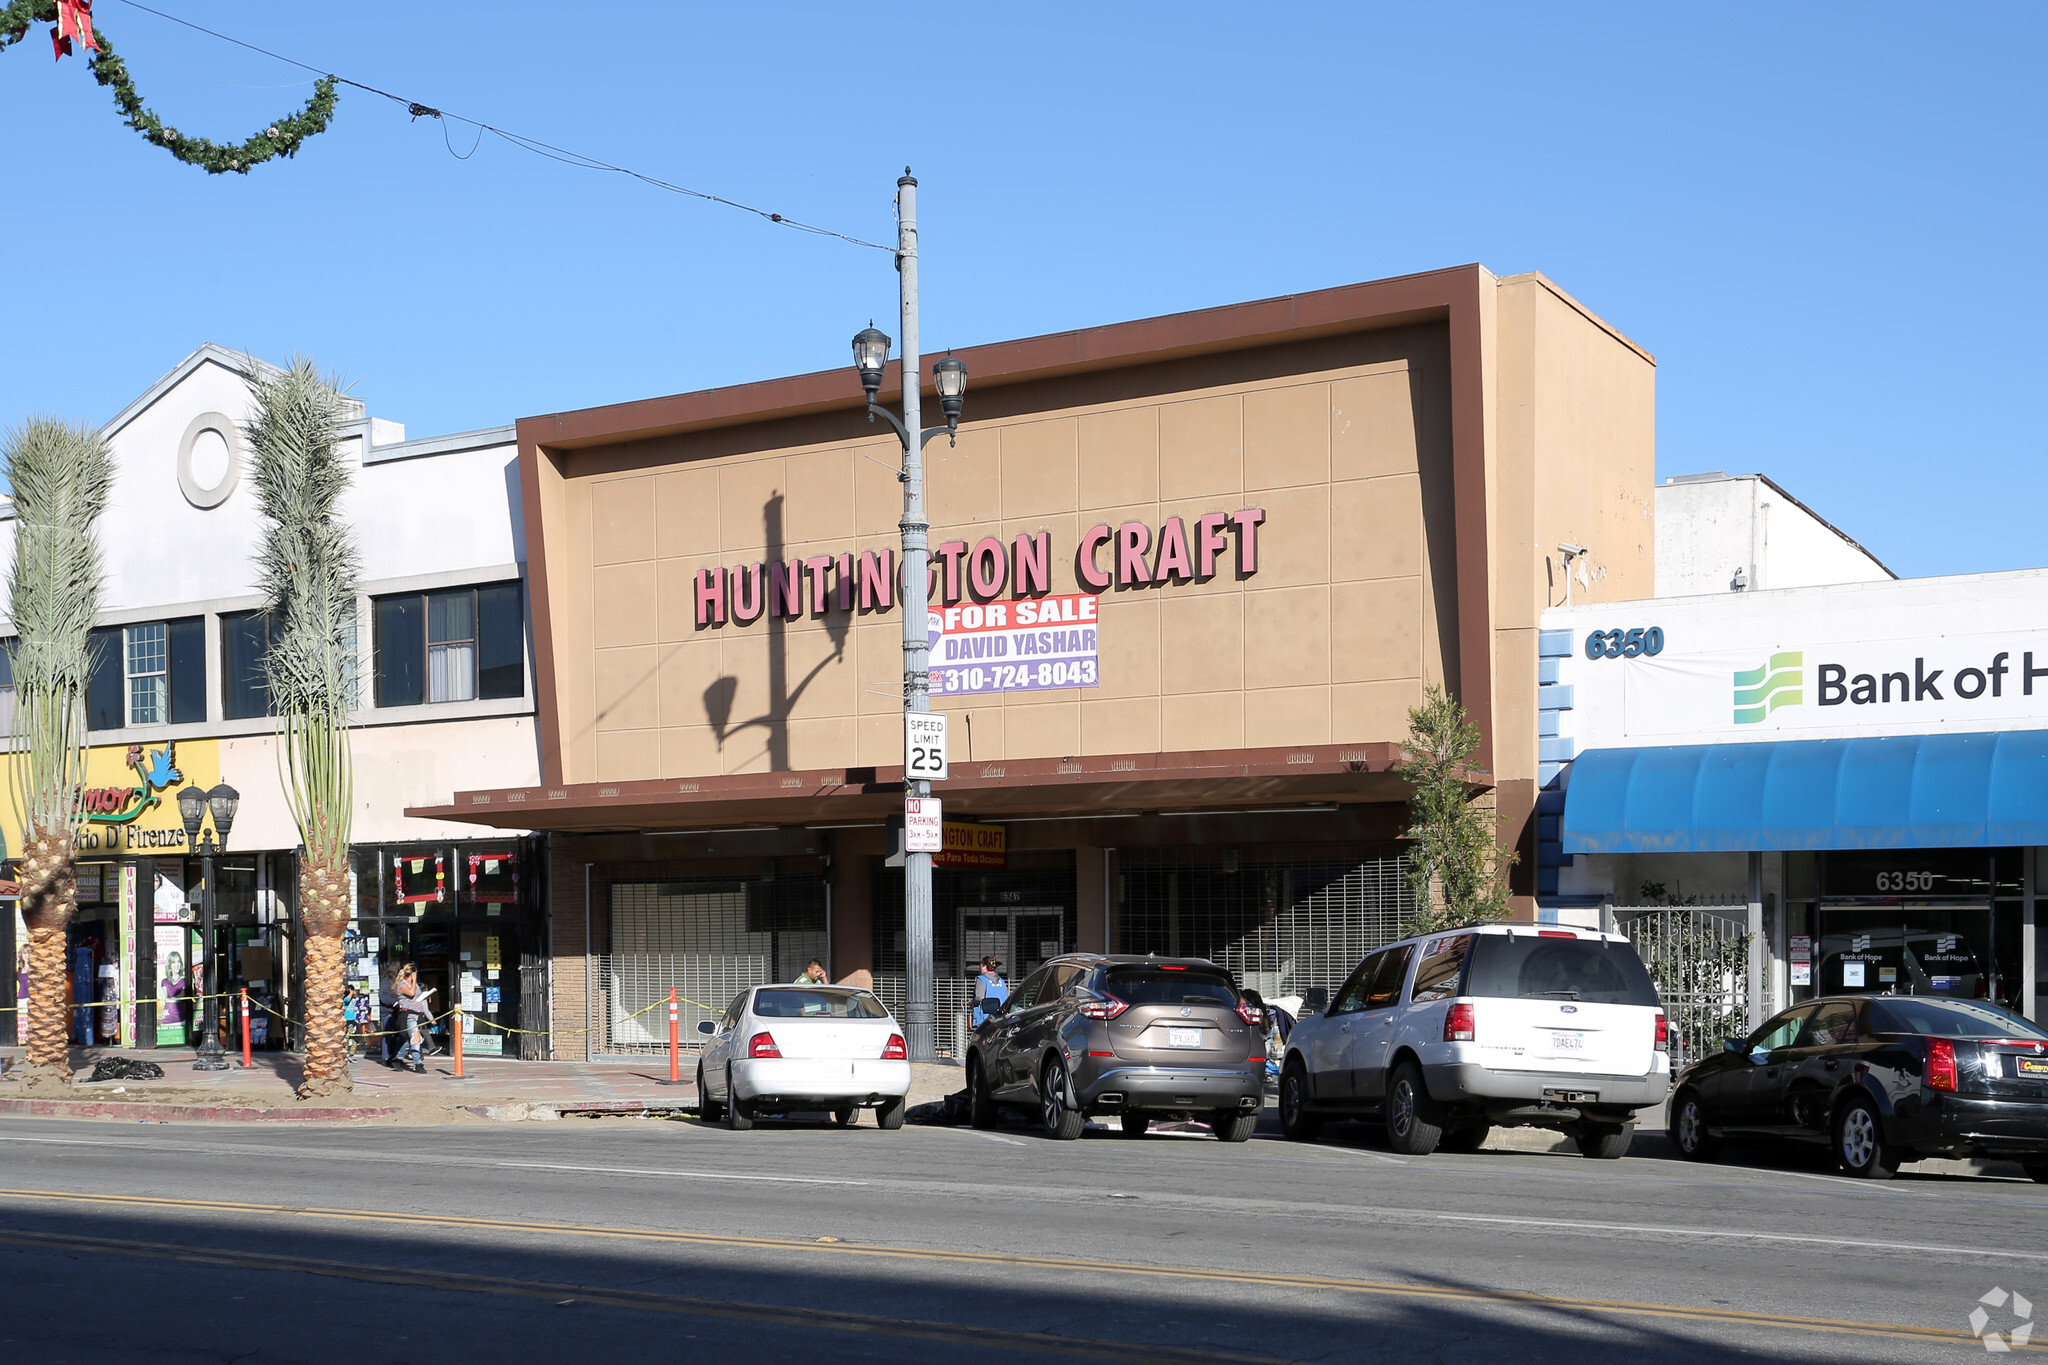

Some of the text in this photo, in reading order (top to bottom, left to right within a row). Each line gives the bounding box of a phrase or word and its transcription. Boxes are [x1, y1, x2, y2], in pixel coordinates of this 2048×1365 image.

[1074, 507, 1266, 594] CRAFT
[944, 595, 1098, 631] FOR SALE
[945, 628, 1097, 660] DAVID YASHAR
[1585, 626, 1665, 660] 6350
[945, 659, 1098, 692] 310-724-8043
[1817, 656, 1945, 707] Bank
[1953, 651, 2009, 699] of
[910, 719, 944, 732] SPEED
[914, 734, 940, 744] LIMIT
[911, 747, 943, 772] 25
[907, 800, 920, 813] NO
[908, 816, 939, 827] PARKING
[127, 823, 187, 849] Firenze
[977, 829, 1004, 849] CRAFT
[947, 853, 961, 862] Para
[963, 854, 978, 863] Toda
[1876, 871, 1933, 892] 6350
[1864, 953, 1882, 962] Hope
[1950, 954, 1969, 963] Hope
[126, 936, 137, 1043] DINERO
[1552, 1037, 1583, 1049] 7DAE474
